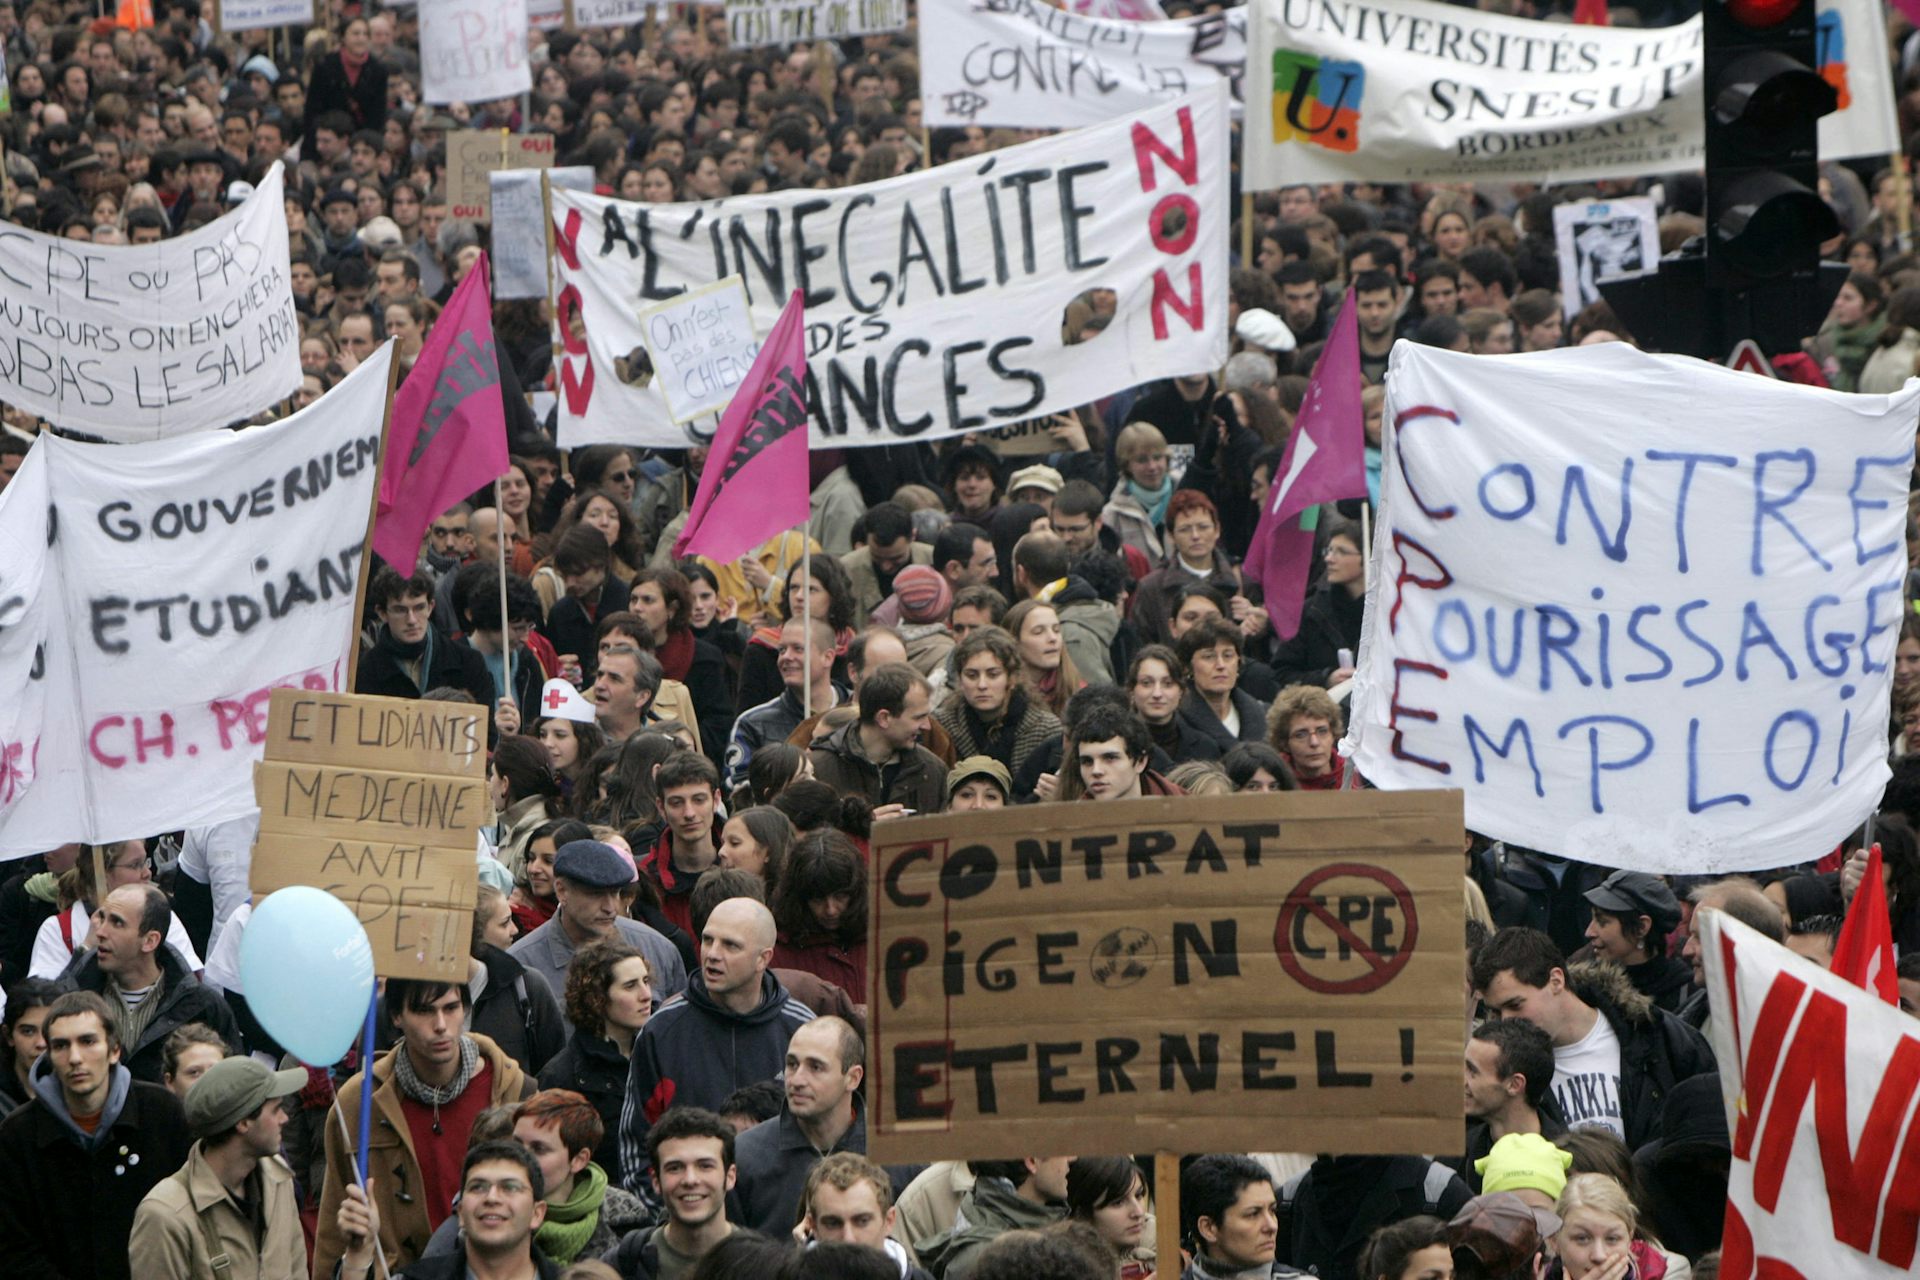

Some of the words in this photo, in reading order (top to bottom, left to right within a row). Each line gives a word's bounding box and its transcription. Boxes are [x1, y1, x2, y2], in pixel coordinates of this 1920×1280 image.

[1283, 0, 1600, 74] UNIVERSITÉS
[1425, 61, 1694, 122] SNESUP
[521, 138, 552, 153] OUI
[1458, 112, 1667, 157] BORDEAUX
[453, 203, 484, 218] OUI
[600, 204, 641, 260] A
[1131, 106, 1204, 340] NON
[193, 221, 262, 301] PAS
[0, 296, 121, 352] UJOURS
[129, 327, 175, 353] ON
[134, 362, 193, 409] LE
[196, 296, 297, 392] SALARIAT
[803, 311, 891, 357] DES
[670, 342, 704, 374] pas
[1394, 404, 1914, 577] CONTRE
[884, 822, 1282, 910] CONTRAT
[1292, 895, 1399, 963] CPE
[893, 1029, 1374, 1121] ETERNEL
